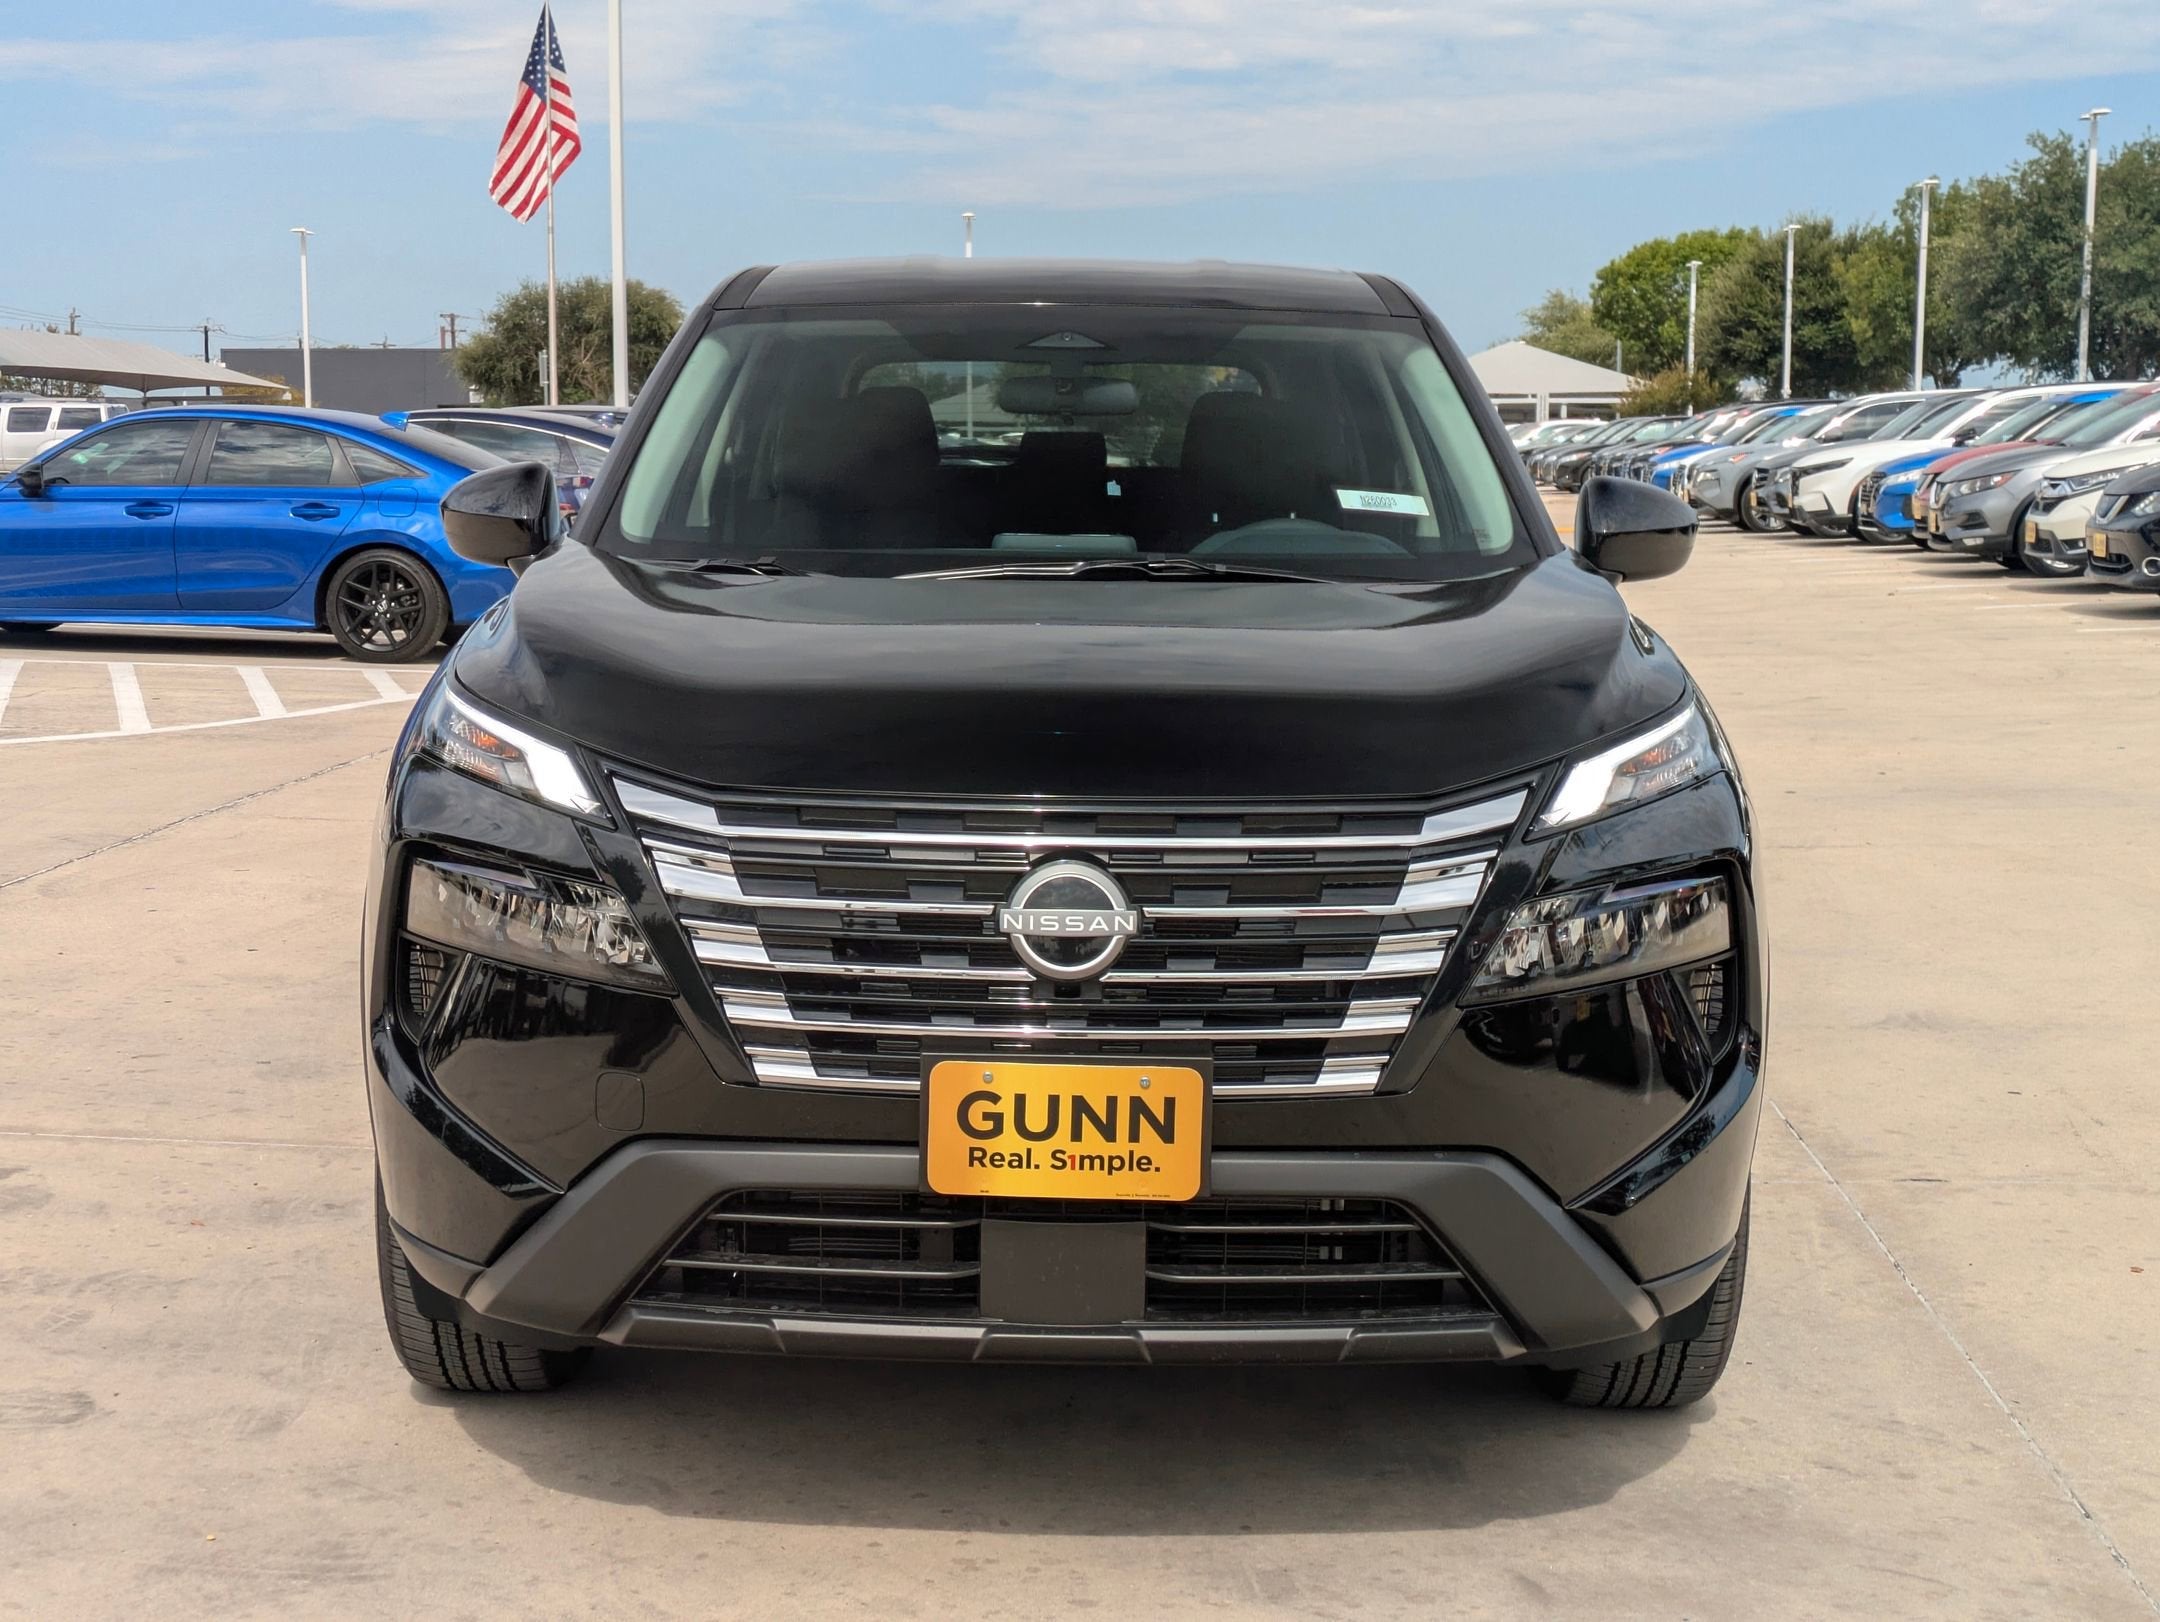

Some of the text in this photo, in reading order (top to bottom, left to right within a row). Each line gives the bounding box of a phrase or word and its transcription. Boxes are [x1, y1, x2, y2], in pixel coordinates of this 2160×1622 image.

[1003, 913, 1134, 931] NISSAN
[956, 1090, 1176, 1144] GUNN
[968, 1146, 1040, 1170] Real.
